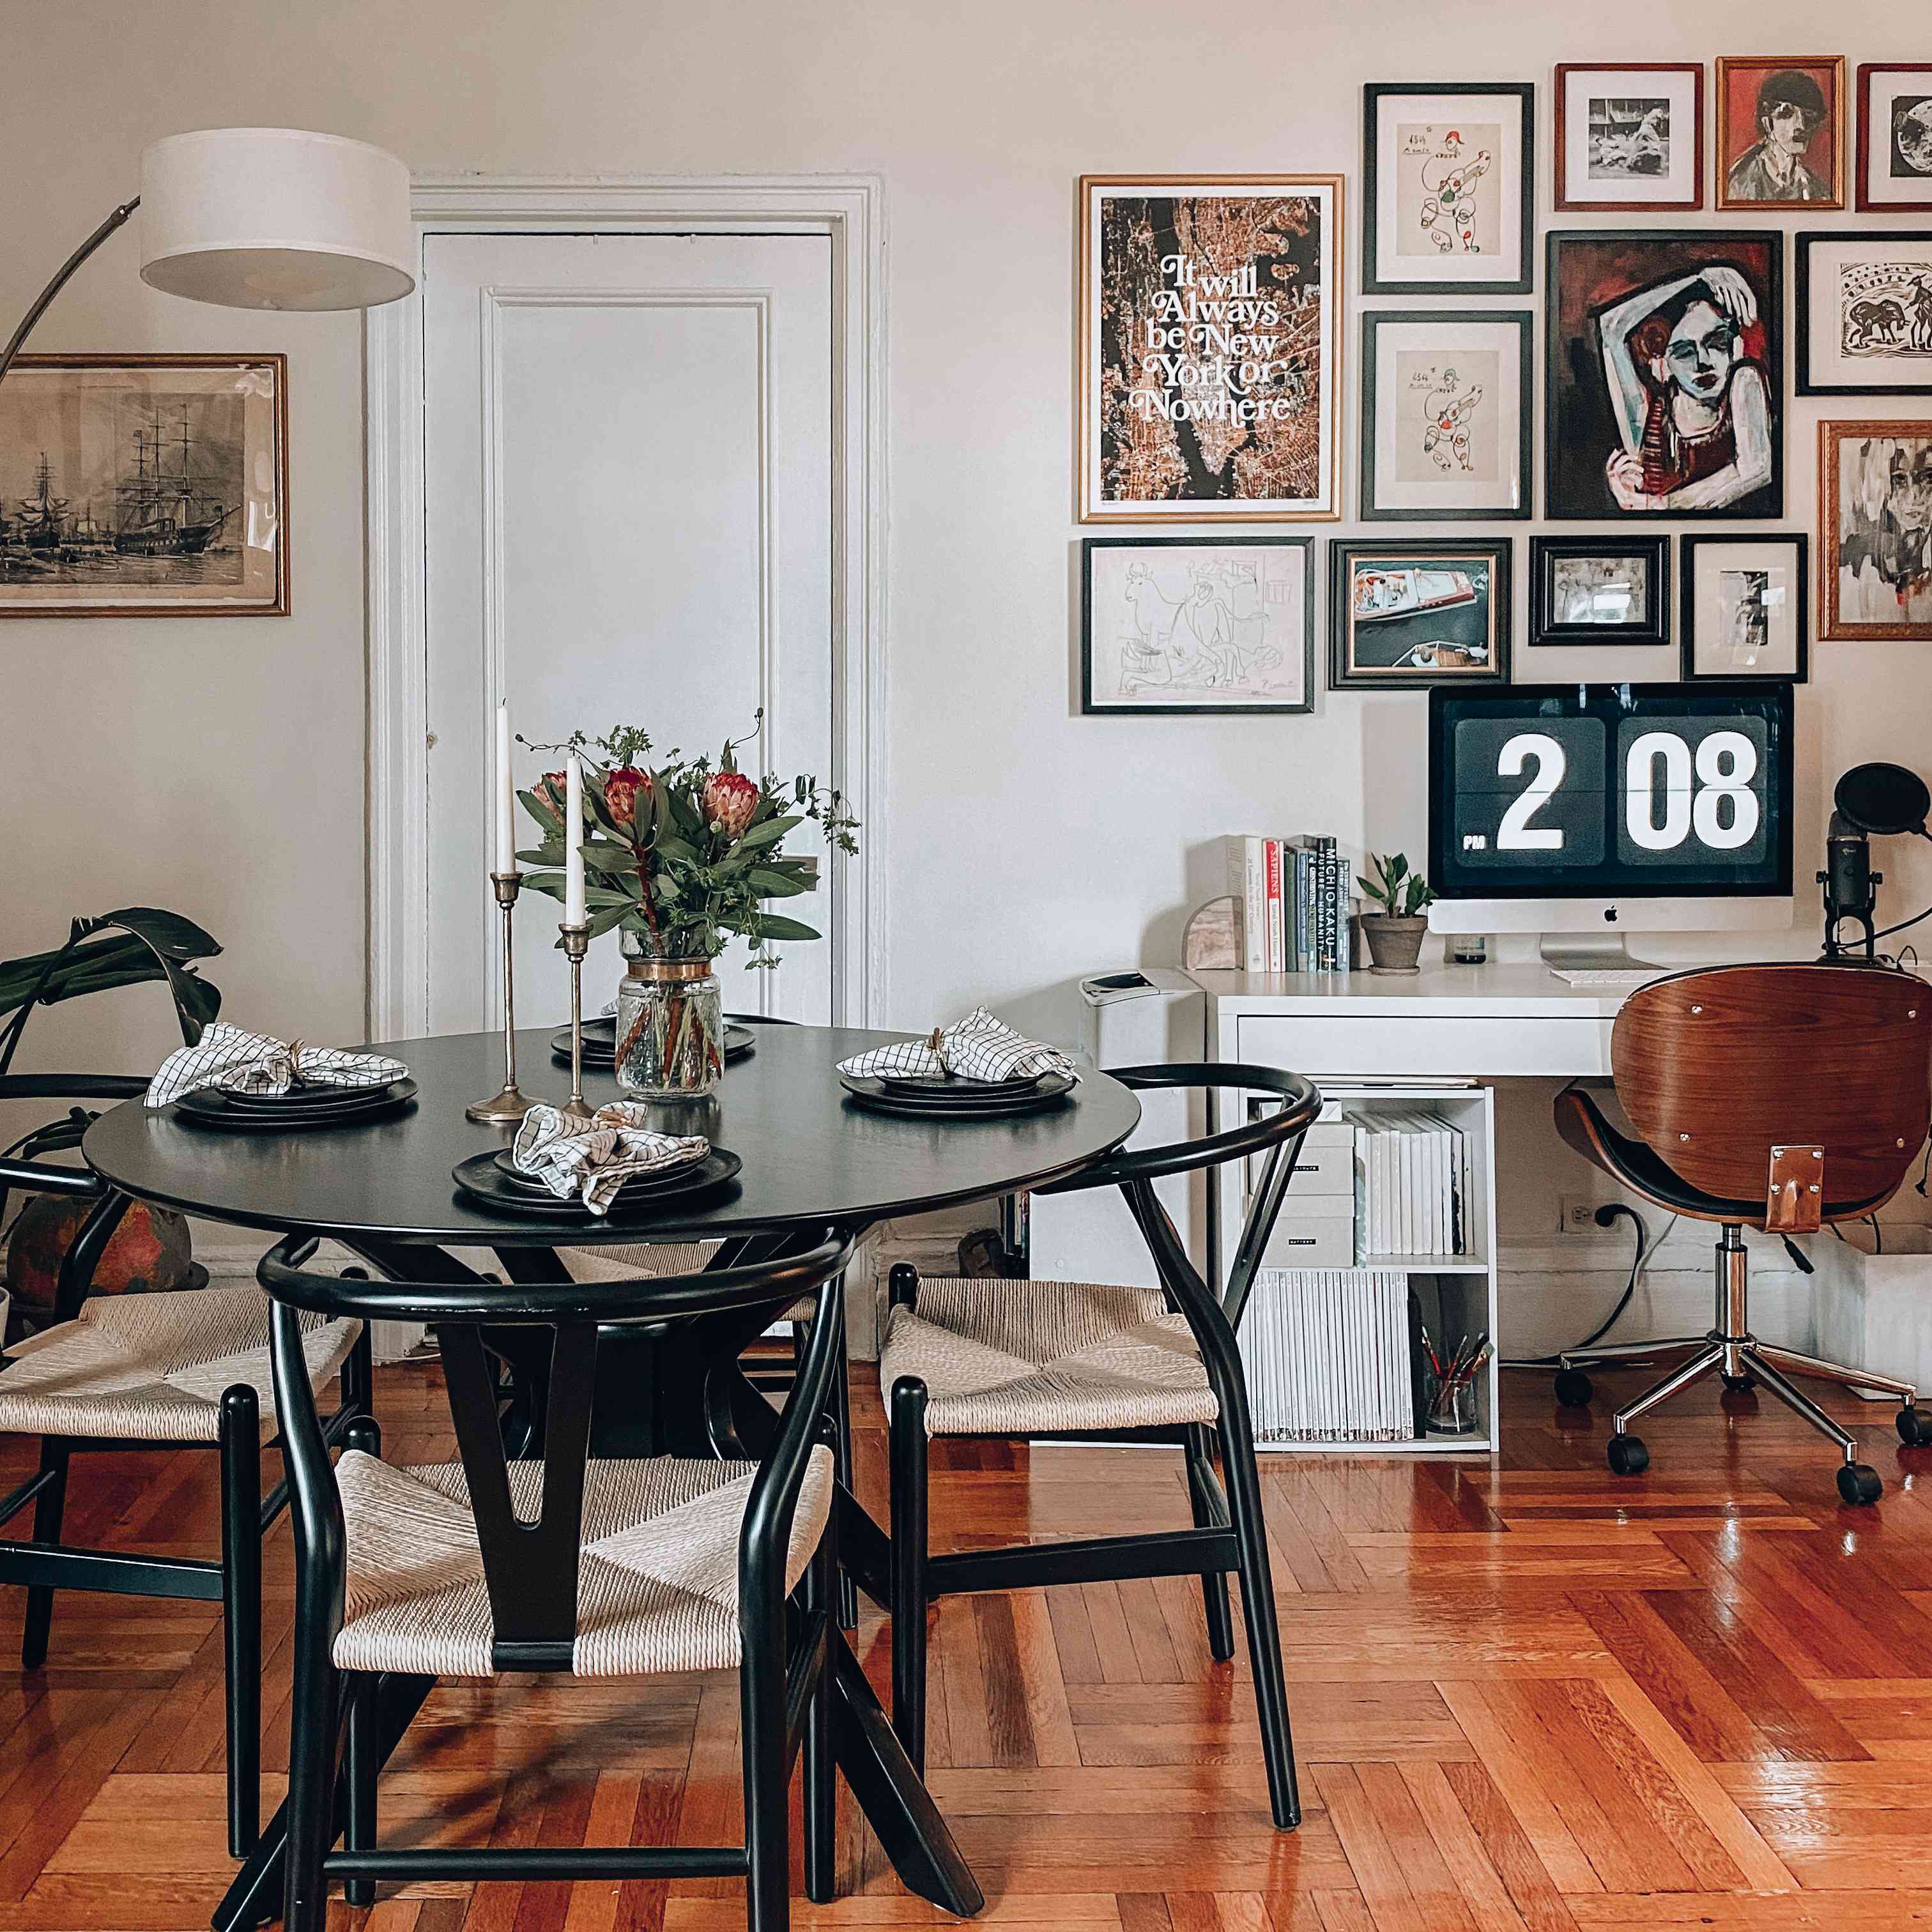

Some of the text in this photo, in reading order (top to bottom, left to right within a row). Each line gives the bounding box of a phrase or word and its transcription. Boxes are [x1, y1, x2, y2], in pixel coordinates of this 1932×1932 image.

[1160, 255, 1257, 298] It will
[1151, 291, 1279, 326] Always
[1146, 316, 1279, 356] be New
[1142, 353, 1288, 395] York or
[1128, 388, 1291, 428] Nowhere
[1496, 731, 1759, 850] 2 08
[1462, 835, 1485, 850] PM
[1270, 850, 1279, 894] SAPIENS
[1325, 848, 1336, 946] MICHIO KAKU
